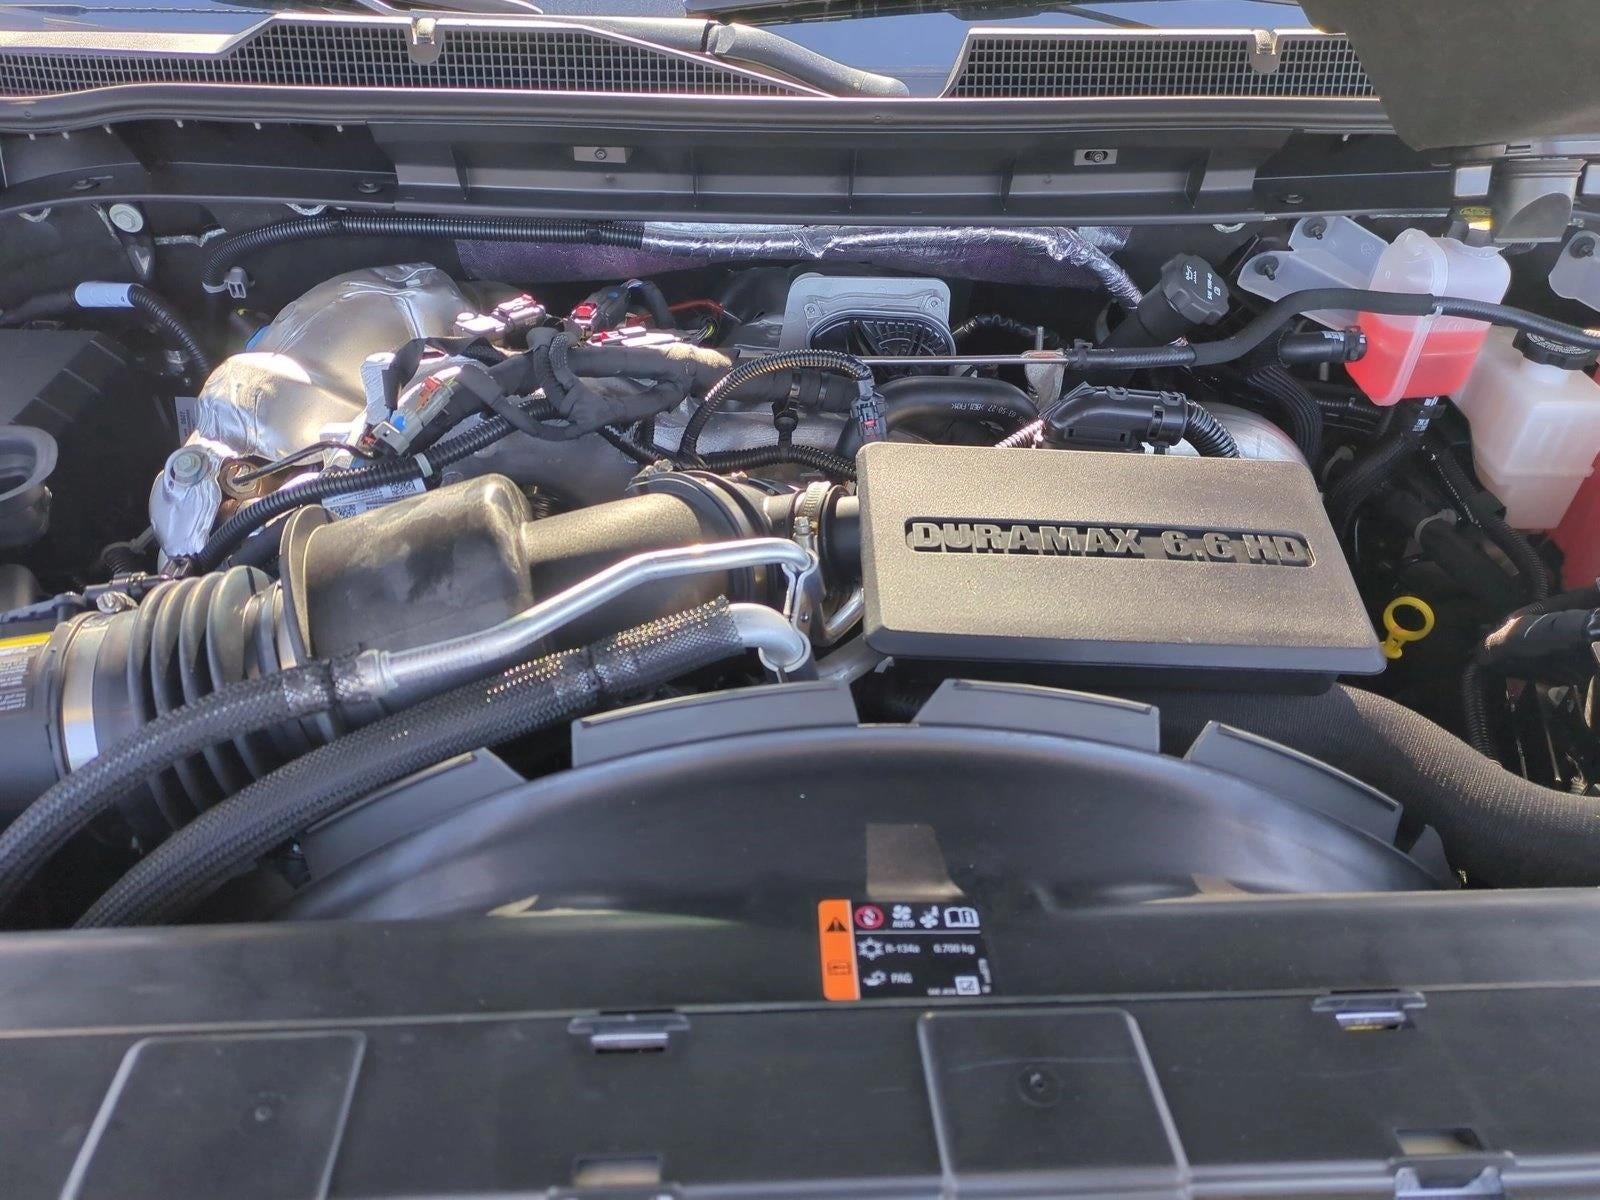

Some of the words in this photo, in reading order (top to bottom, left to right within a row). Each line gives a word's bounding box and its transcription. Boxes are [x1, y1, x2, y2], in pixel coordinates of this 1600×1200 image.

[912, 522, 1145, 558] DURAMAX
[1160, 531, 1235, 562] 6.6
[1243, 533, 1312, 566] HD
